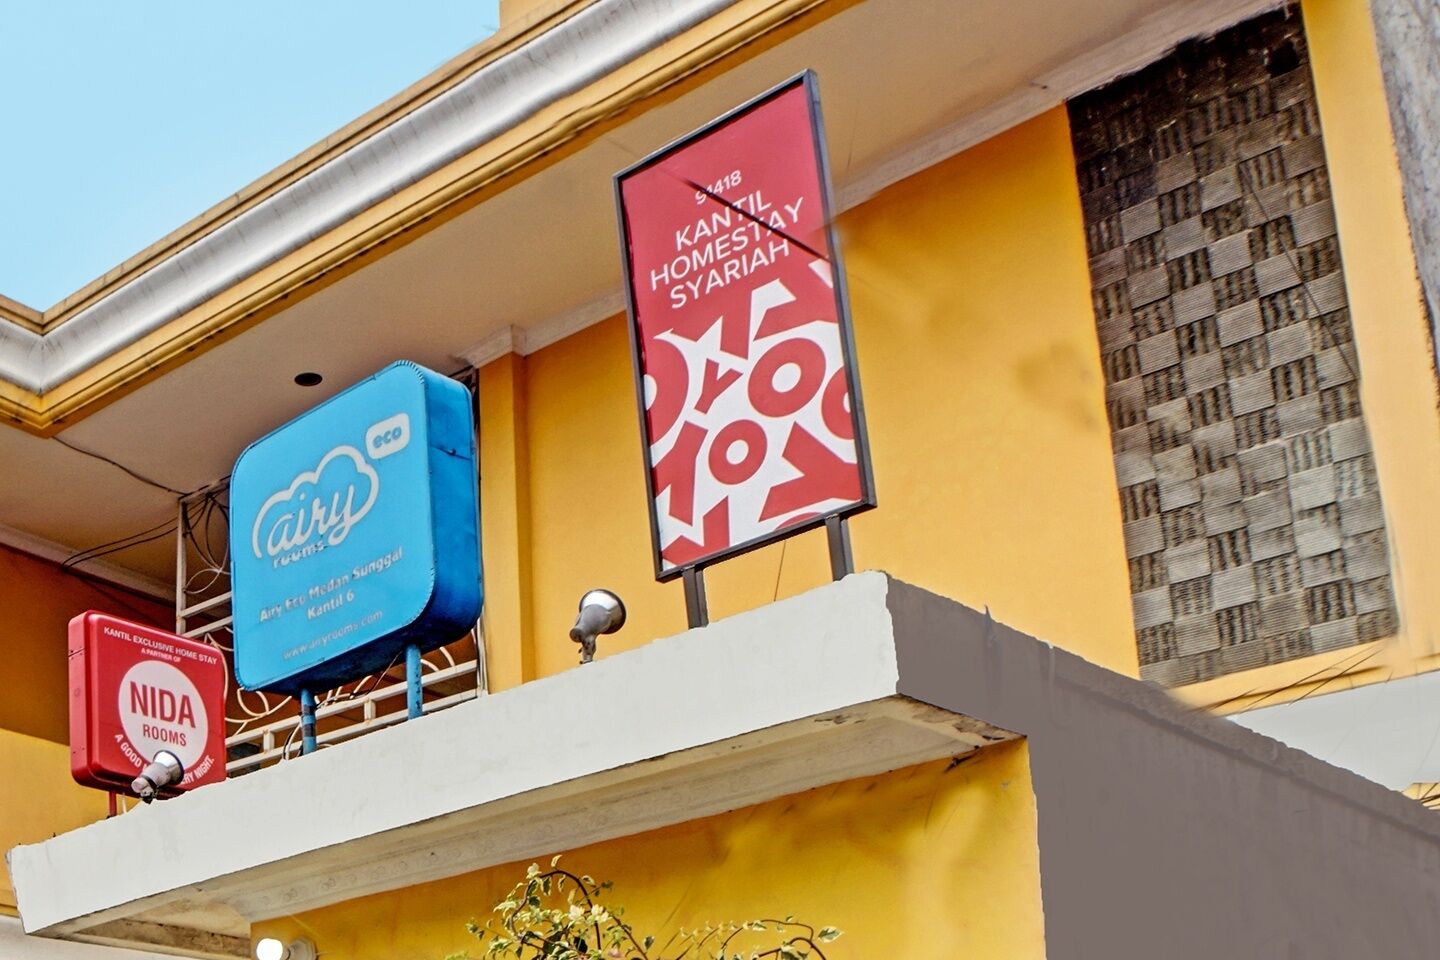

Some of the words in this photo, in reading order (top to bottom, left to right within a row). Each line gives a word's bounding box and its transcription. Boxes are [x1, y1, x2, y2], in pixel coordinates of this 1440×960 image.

[675, 190, 772, 252] KANTIL
[650, 196, 804, 292] HOMESTAY
[669, 238, 790, 309] SYARIAH
[371, 424, 403, 450] eco
[267, 484, 356, 555] airy
[273, 540, 325, 568] rooms
[260, 604, 282, 622] Airy
[308, 574, 350, 600] Medan
[351, 545, 403, 580] Sunggal
[307, 593, 343, 619] Kantil
[346, 588, 355, 602] 6
[103, 626, 132, 642] KANTIL
[133, 634, 174, 653] EXCLUSIVE
[175, 647, 198, 660] HOME
[198, 654, 218, 665] STAY
[129, 681, 196, 729] NIDA
[114, 734, 124, 743] A
[120, 742, 143, 768] GOOD
[142, 723, 187, 747] ROOMS
